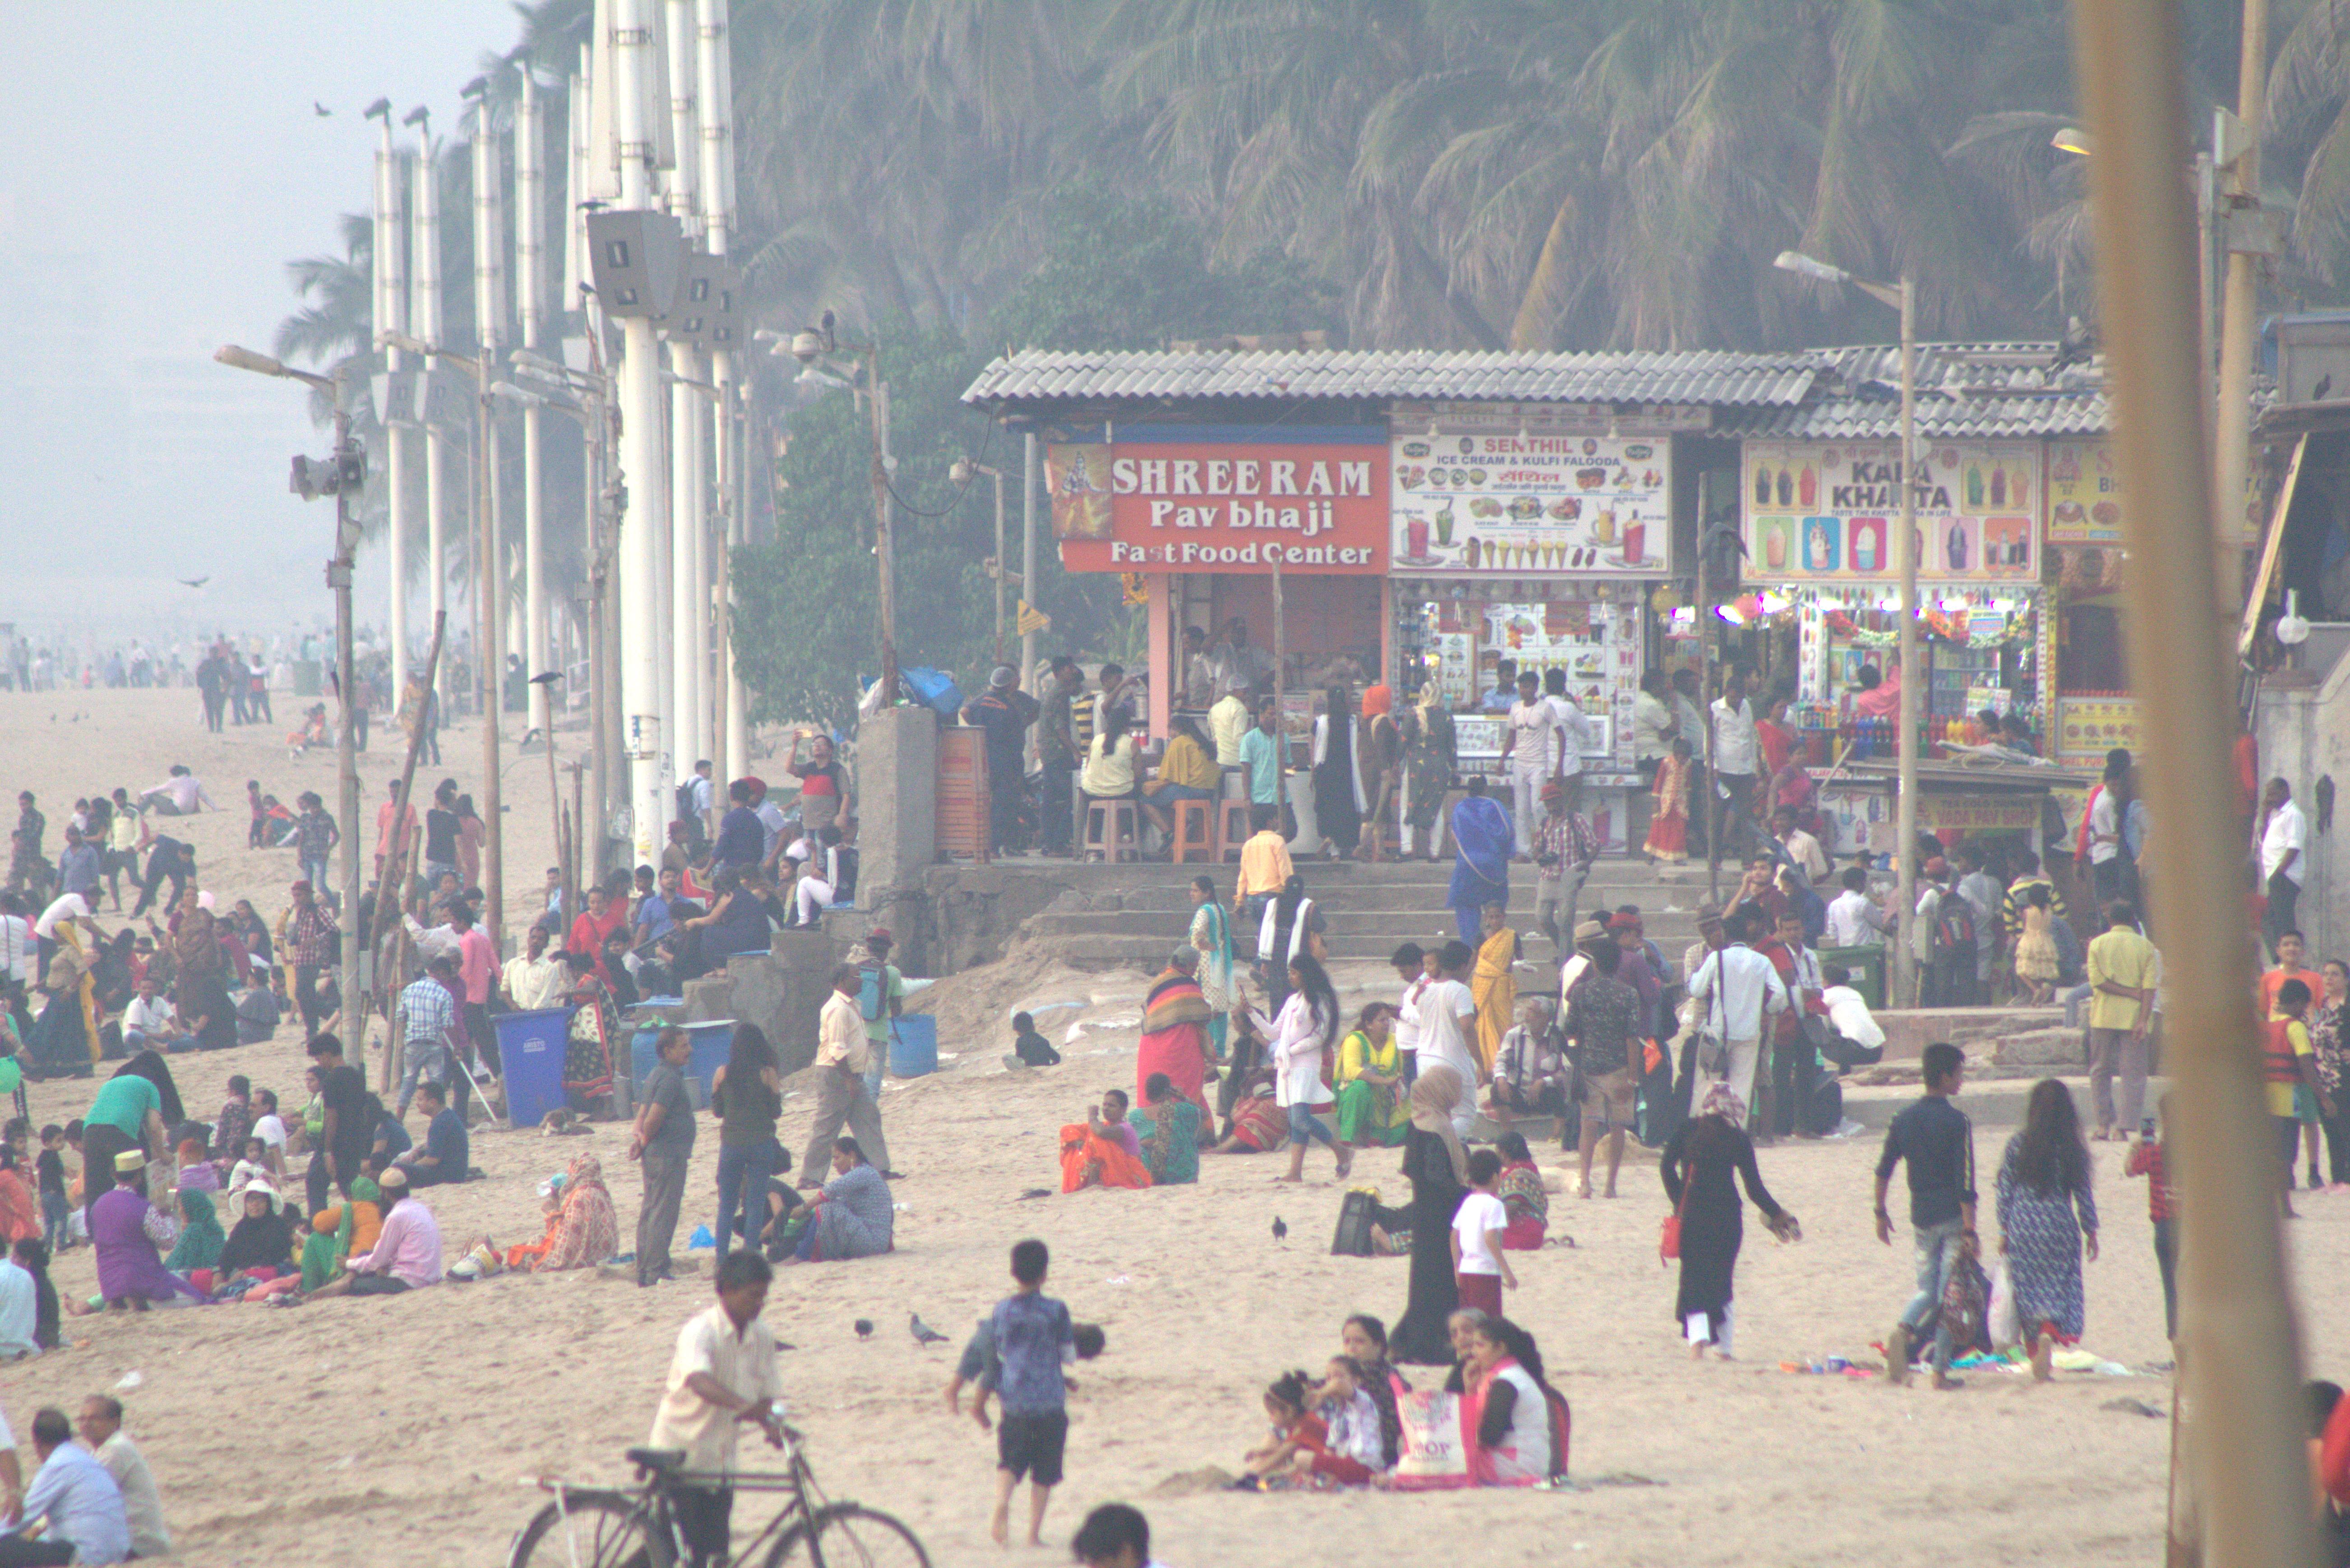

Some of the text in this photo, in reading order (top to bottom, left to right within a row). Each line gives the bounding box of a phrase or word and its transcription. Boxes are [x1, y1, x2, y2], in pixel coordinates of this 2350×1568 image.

[1484, 438, 1573, 454] SENTHIL
[1437, 456, 1621, 467] ICE CREAM & KULFI FALOODA
[1112, 458, 1372, 497] SHREE RAM
[1832, 485, 1953, 508] KHATA
[1149, 500, 1334, 536] Pav bhaji
[1181, 541, 1258, 564] Food
[1262, 542, 1373, 564] Center
